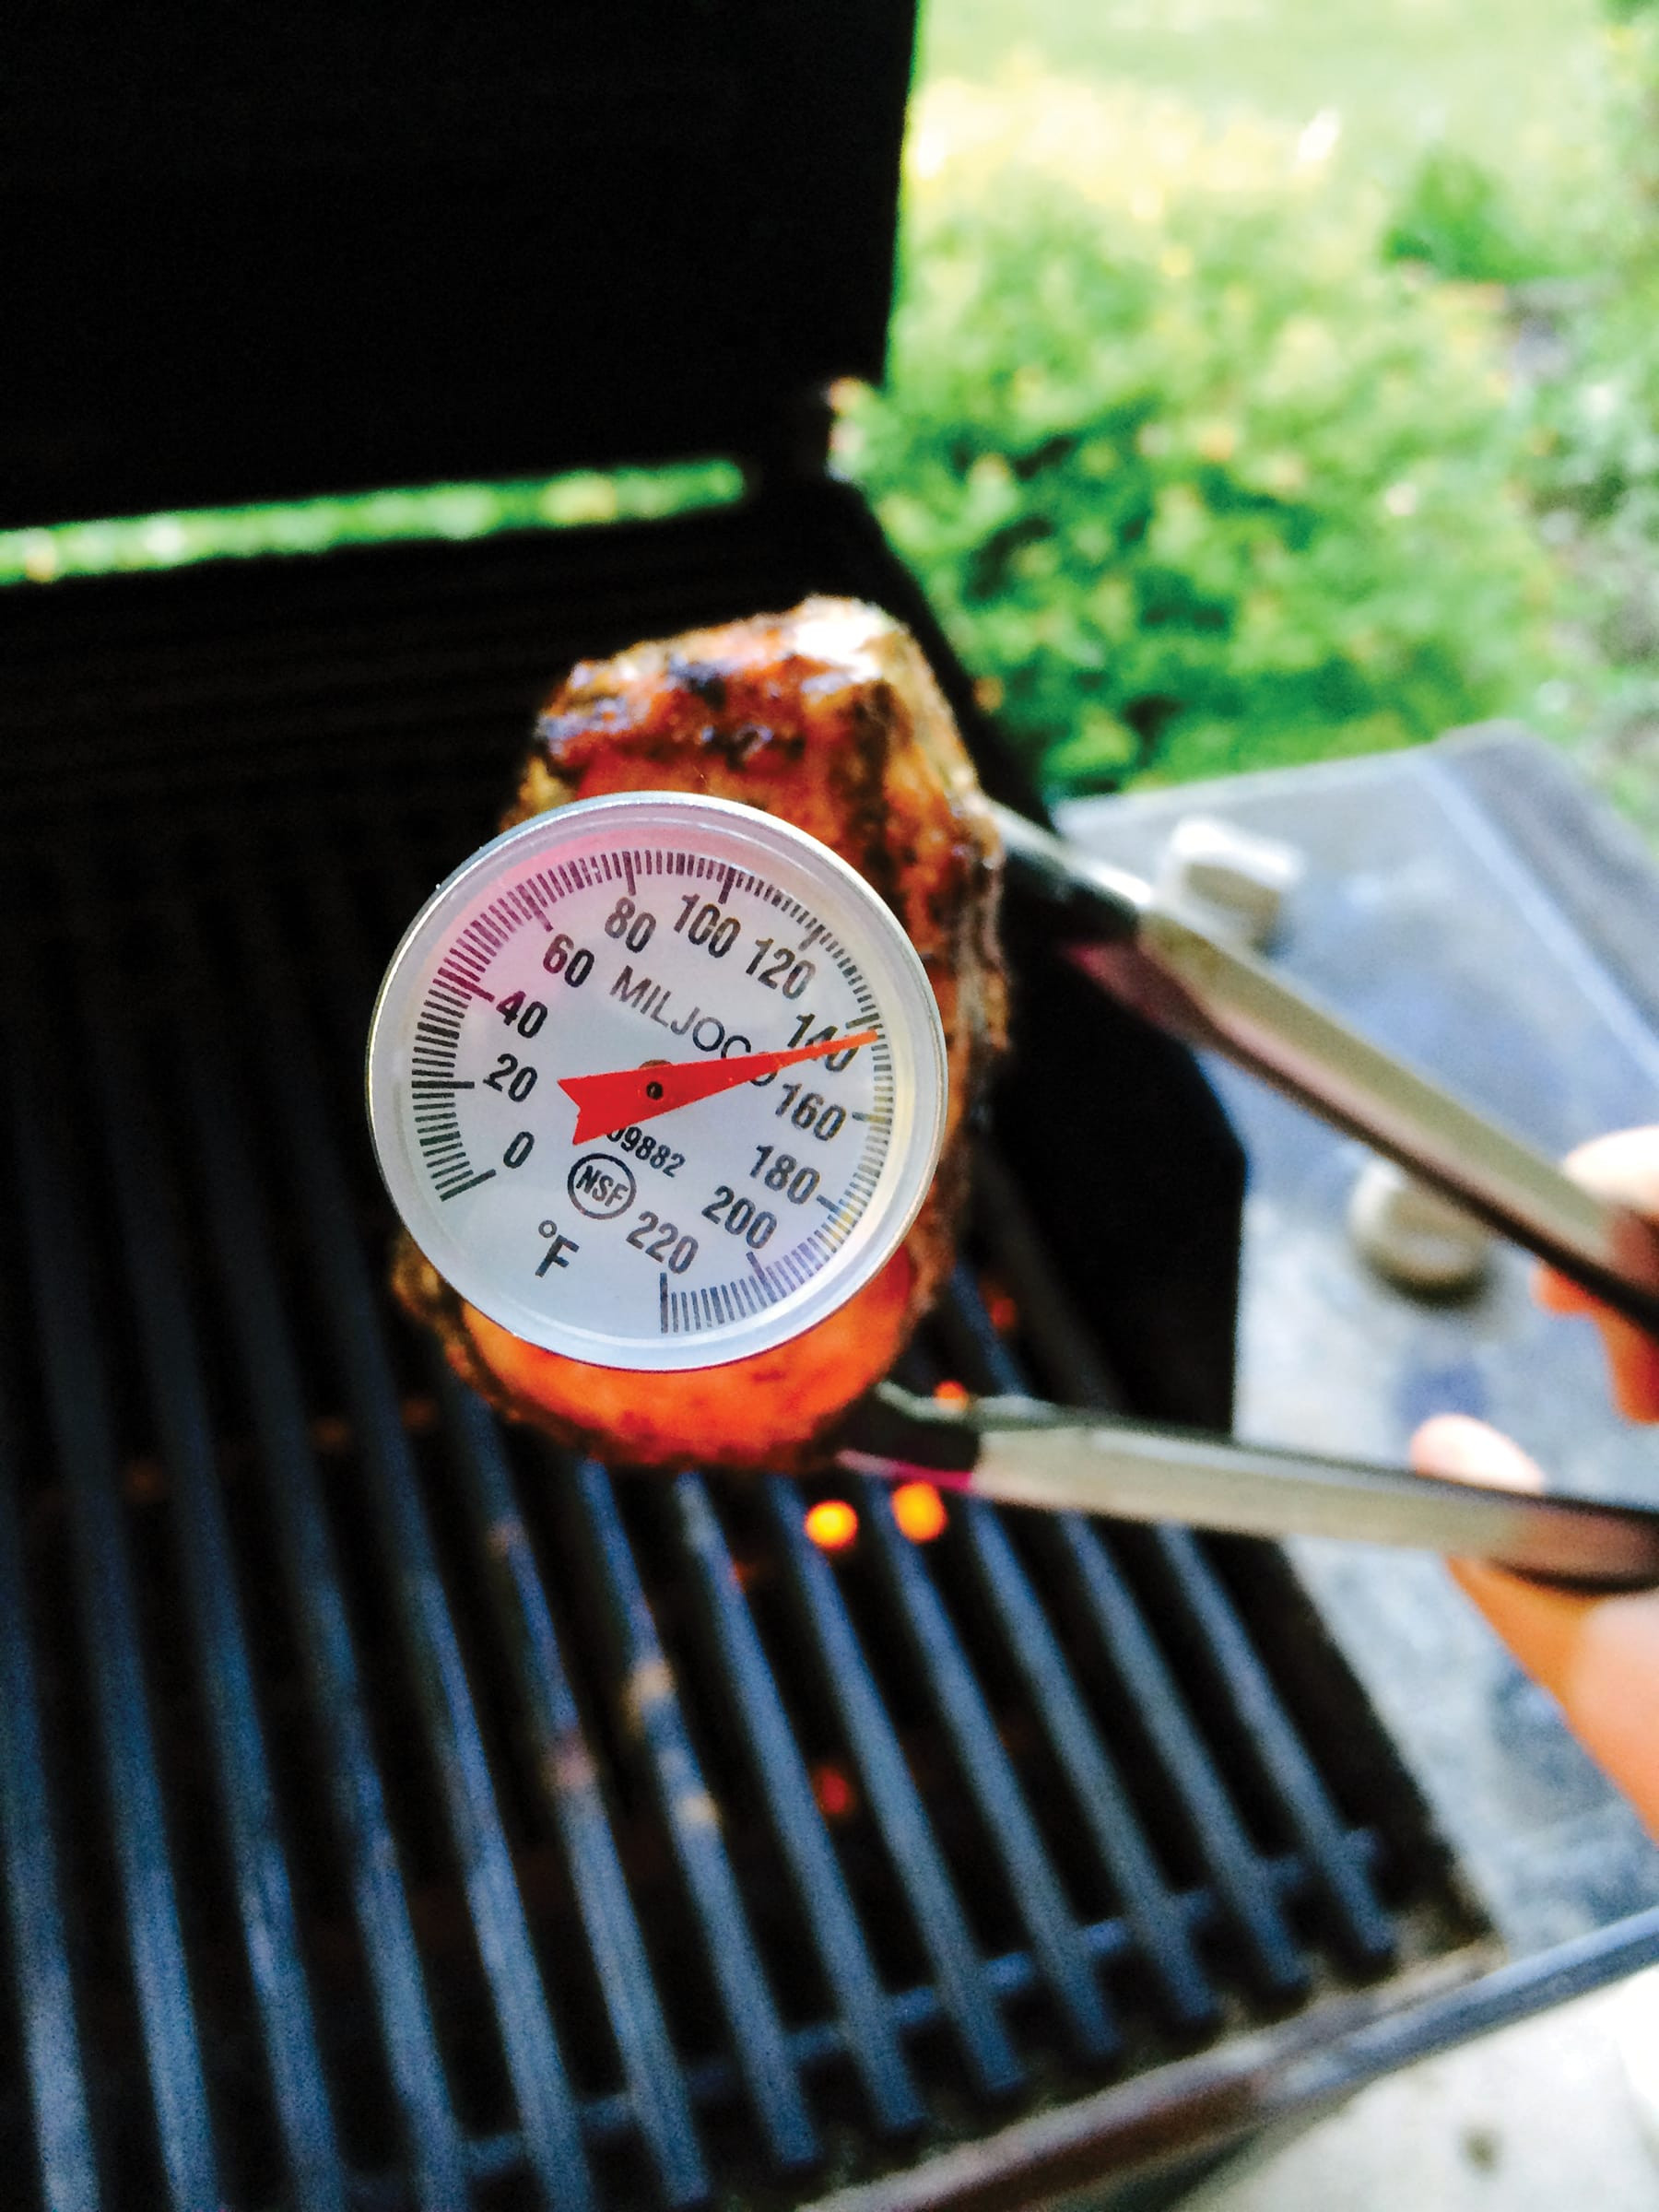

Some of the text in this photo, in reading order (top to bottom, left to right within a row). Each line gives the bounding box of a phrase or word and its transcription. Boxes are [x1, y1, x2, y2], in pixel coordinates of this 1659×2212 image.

[605, 897, 656, 953] 80
[674, 893, 741, 958] 100
[543, 934, 594, 987] 60
[746, 937, 816, 999] 120
[496, 990, 547, 1039] 40
[787, 1013, 859, 1072] 140
[483, 1053, 538, 1102] 20
[775, 1083, 846, 1141] 160
[503, 1131, 535, 1169] 0
[749, 1145, 820, 1205] 180
[576, 1164, 629, 1207] NSF
[626, 1211, 699, 1275] 220
[701, 1185, 777, 1249] 200
[535, 1219, 581, 1277] °F
